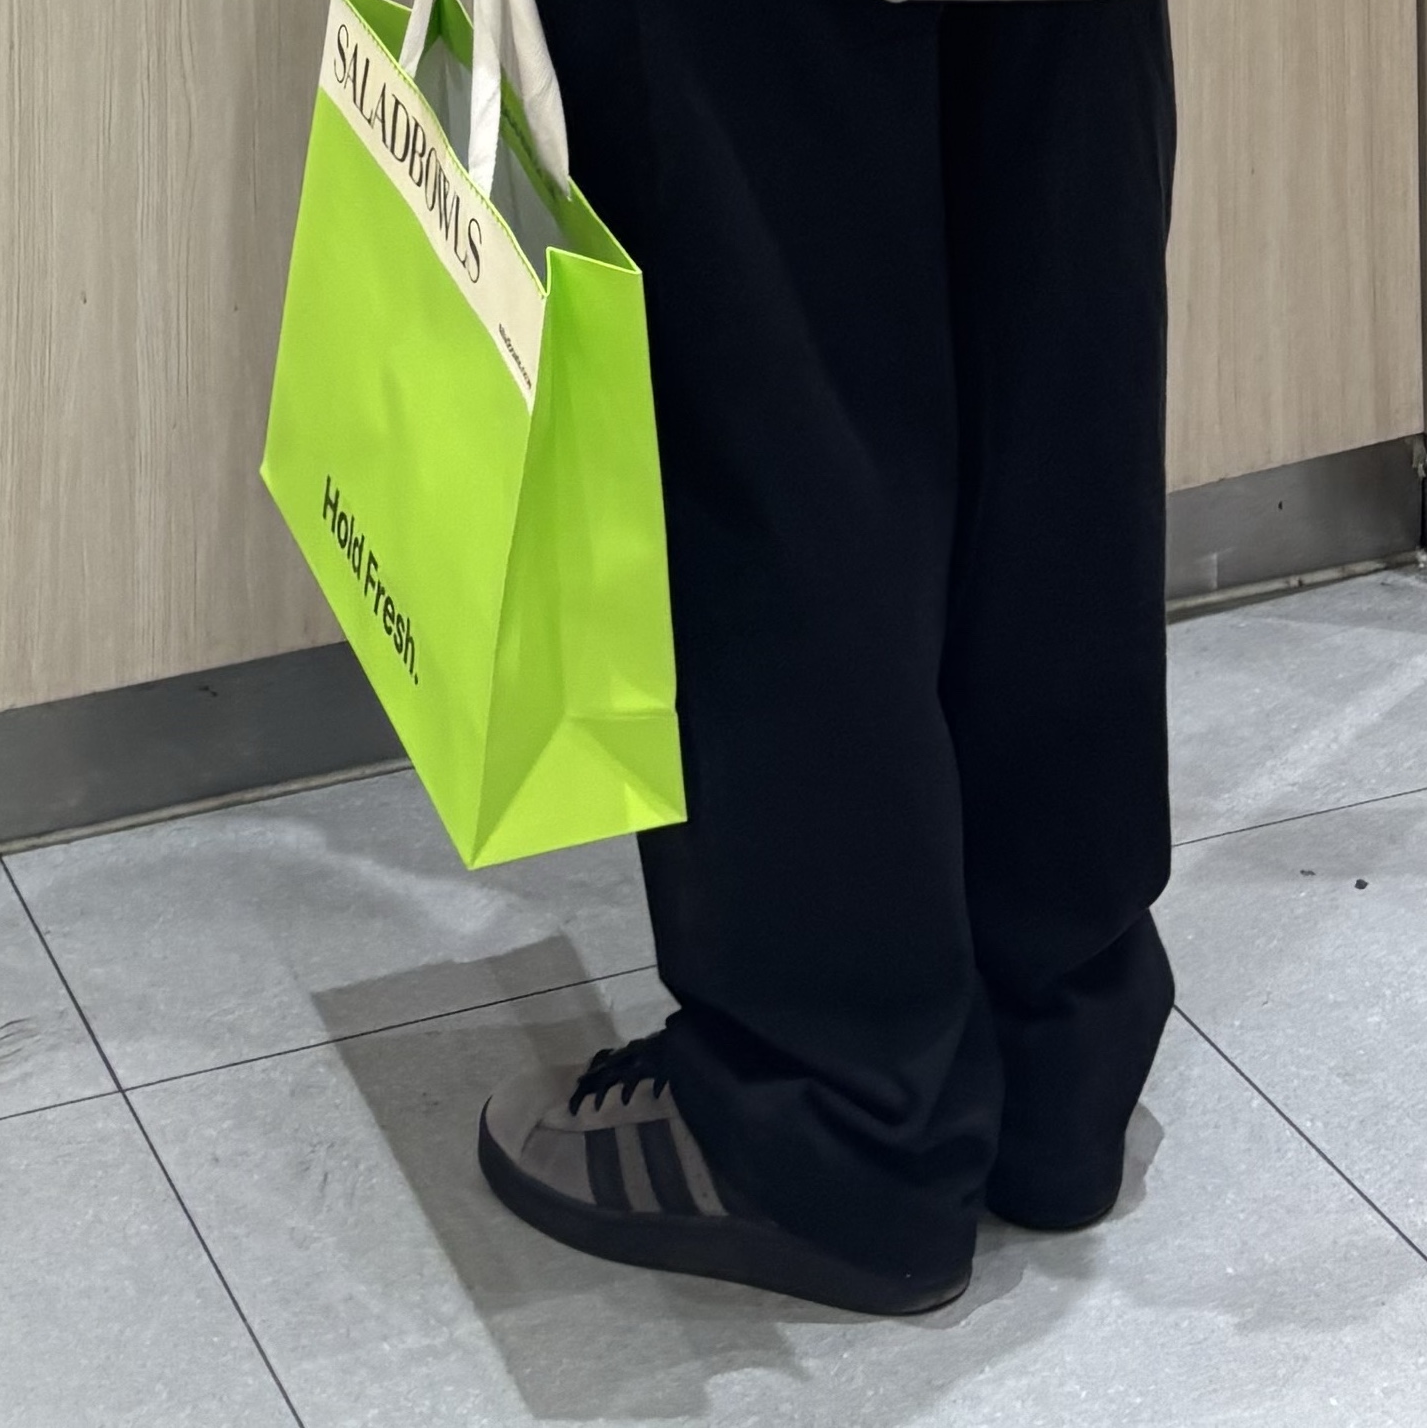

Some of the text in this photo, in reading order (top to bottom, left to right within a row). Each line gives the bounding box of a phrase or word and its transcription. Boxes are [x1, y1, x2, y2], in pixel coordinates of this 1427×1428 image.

[333, 24, 481, 283] SALADBOWLS
[323, 474, 419, 686] Hold Fresh.
